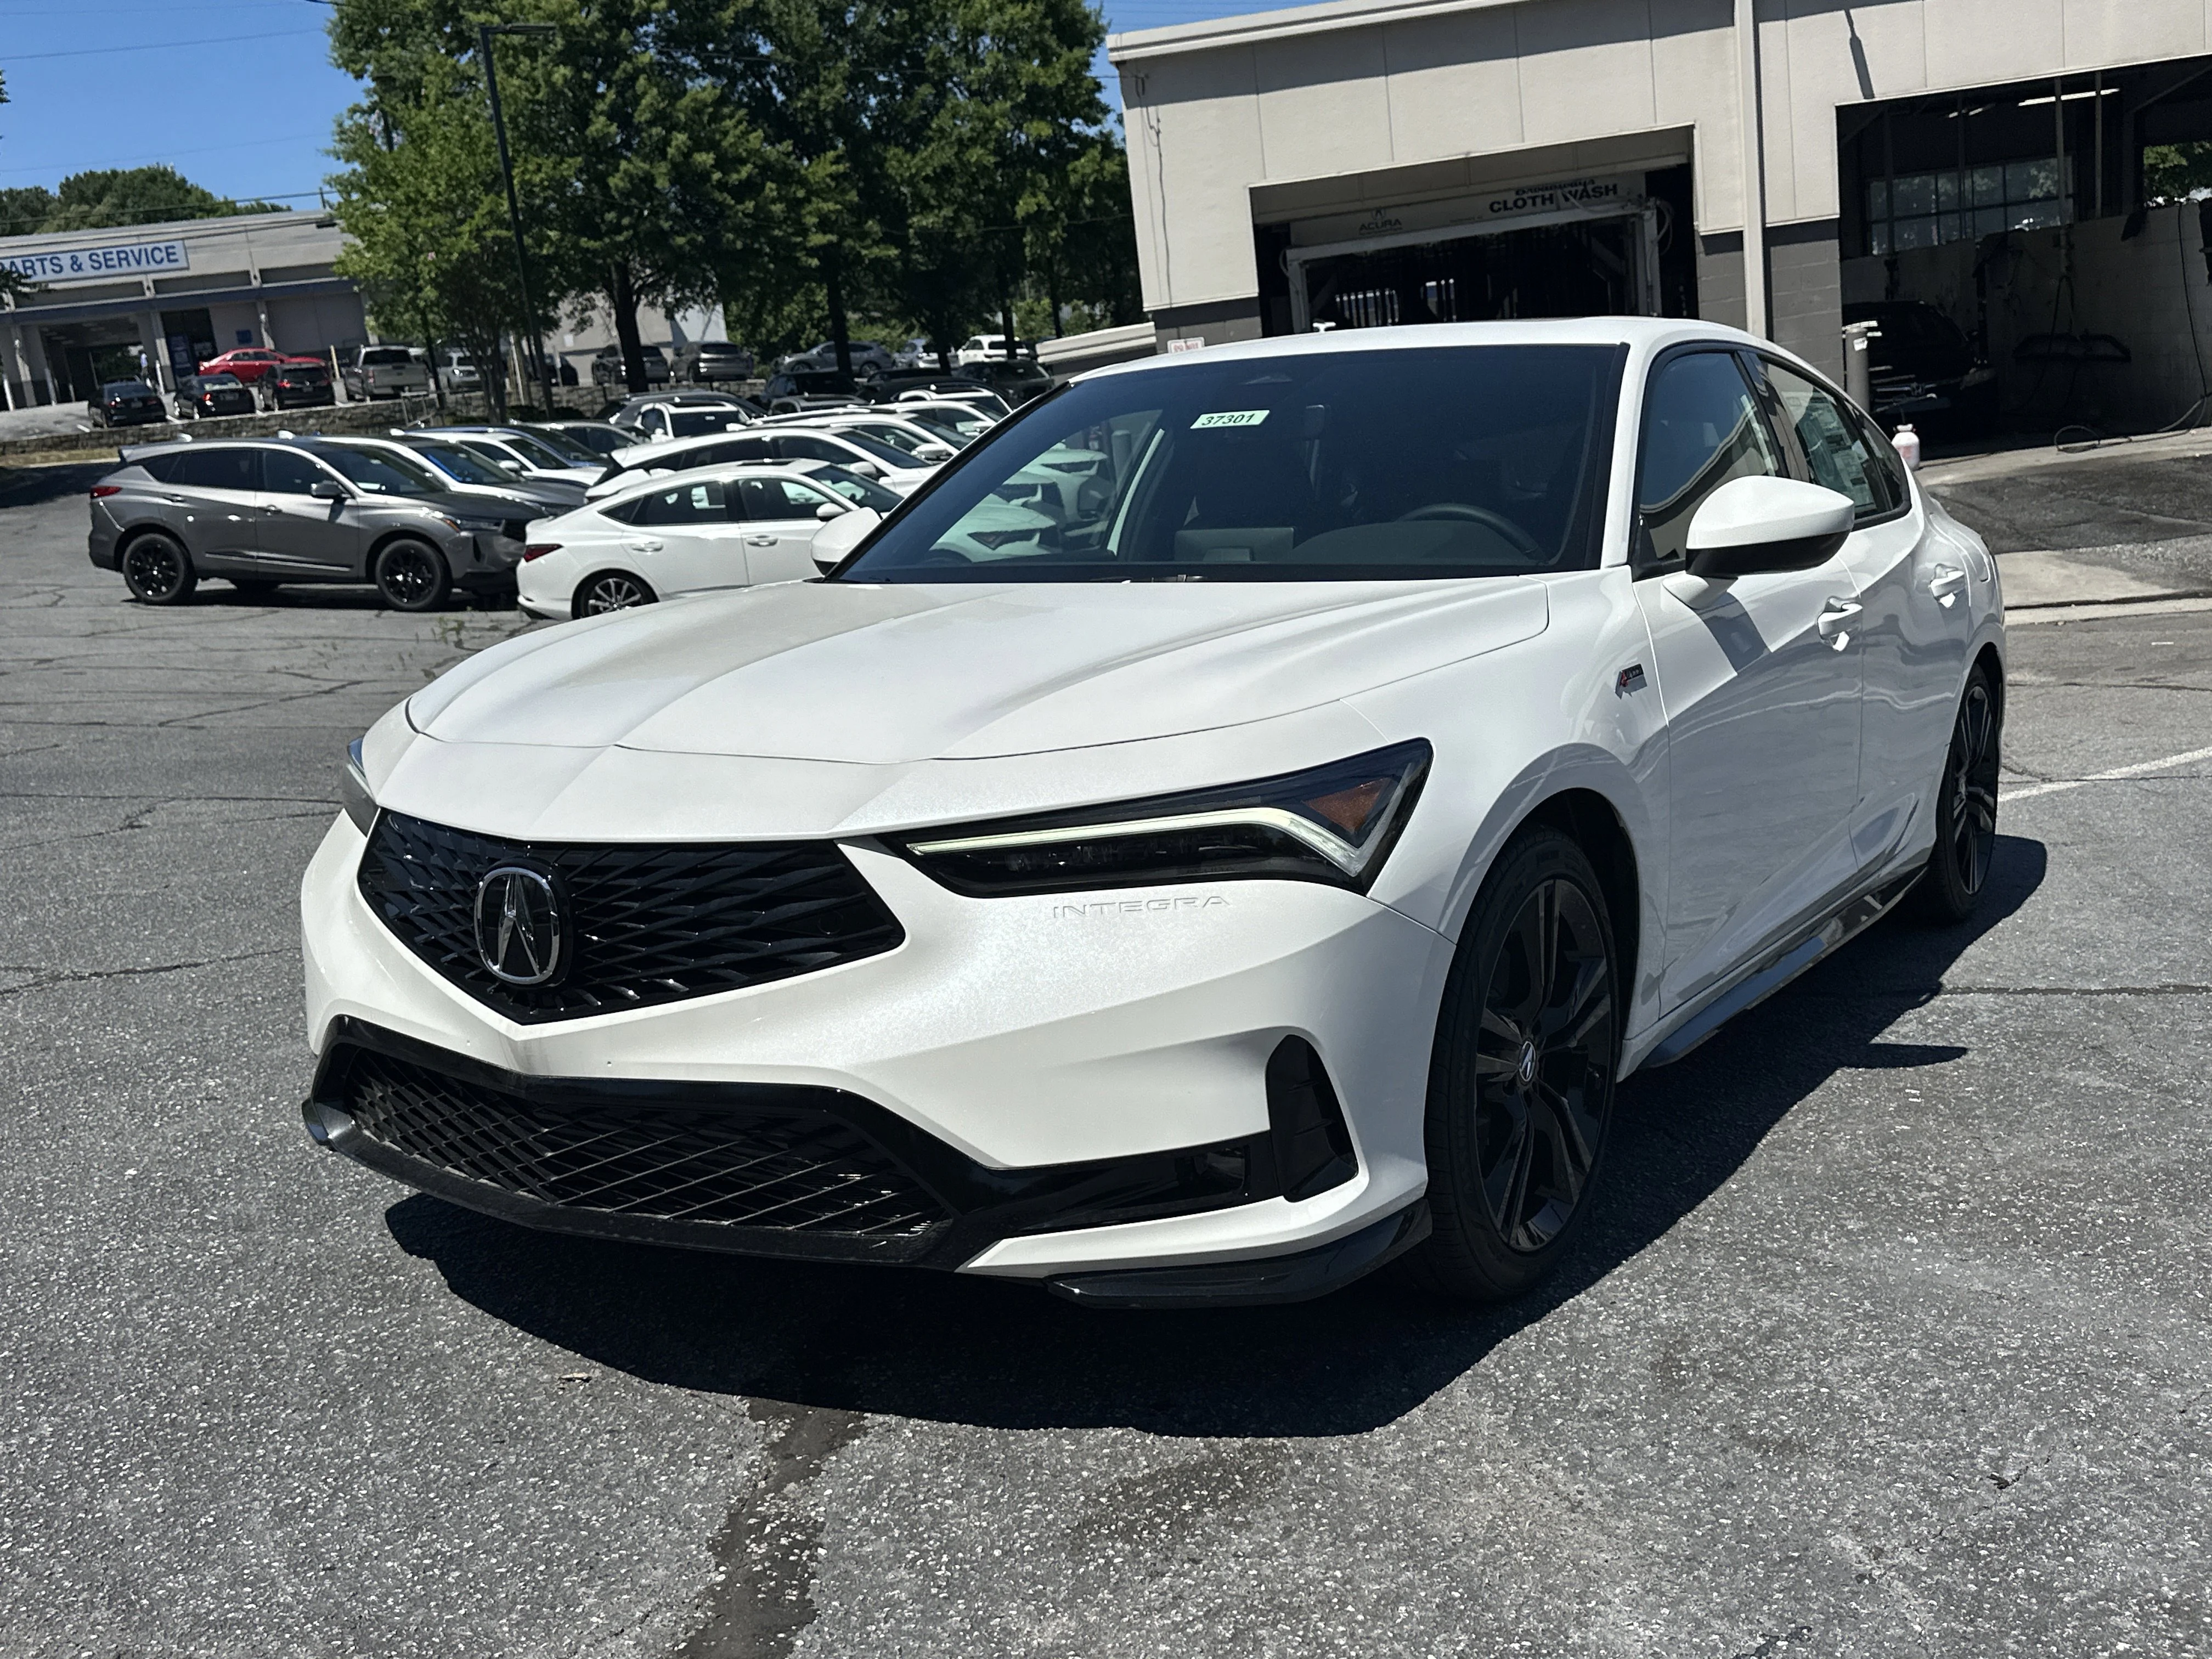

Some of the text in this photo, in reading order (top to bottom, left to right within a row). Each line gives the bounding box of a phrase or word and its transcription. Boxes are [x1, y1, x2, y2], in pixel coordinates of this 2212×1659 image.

[1489, 193, 1554, 213] CLOTH
[1564, 184, 1618, 202] WASH
[1359, 218, 1402, 230] ACURA
[71, 254, 83, 272] &
[88, 245, 179, 270] SERVICE
[1201, 414, 1255, 426] 37301
[1053, 896, 1230, 918] INTEGRA
